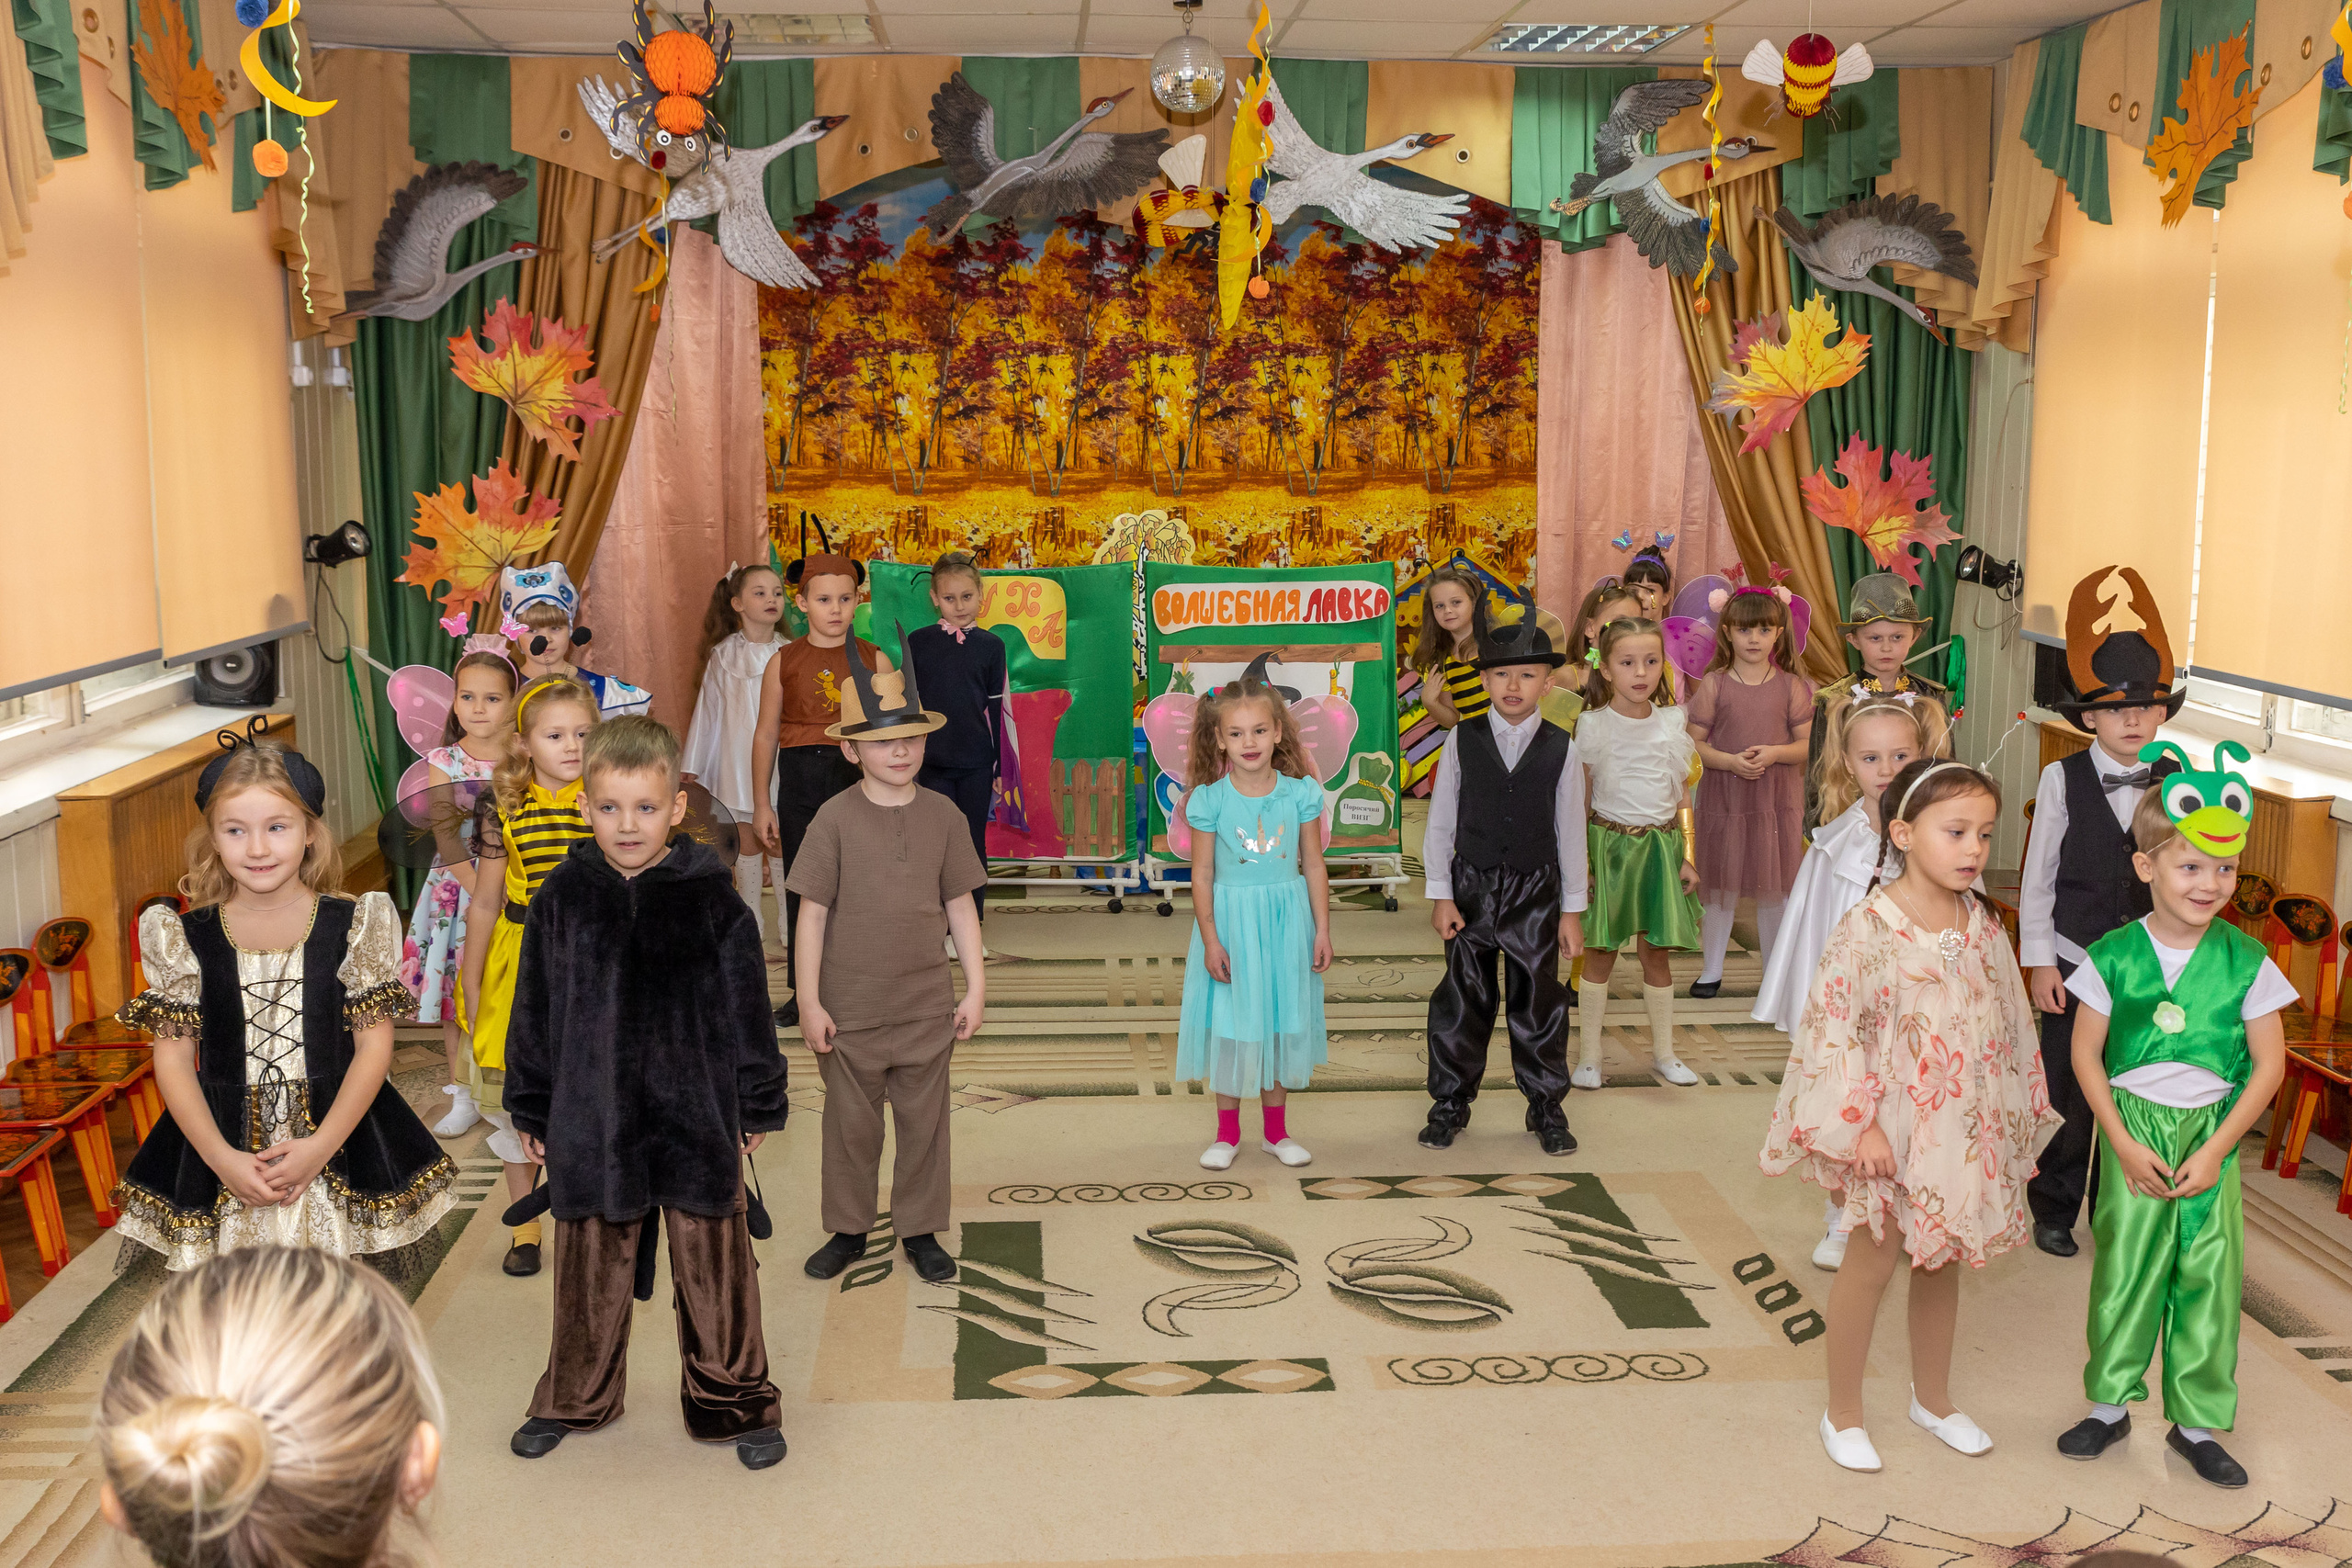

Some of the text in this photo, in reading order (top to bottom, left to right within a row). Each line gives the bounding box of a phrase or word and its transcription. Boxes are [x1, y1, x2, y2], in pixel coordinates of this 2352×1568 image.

[1154, 587, 1389, 626] ВОЛШЕБНАЯ ЛАВКА
[1343, 803, 1380, 813] Поросячий
